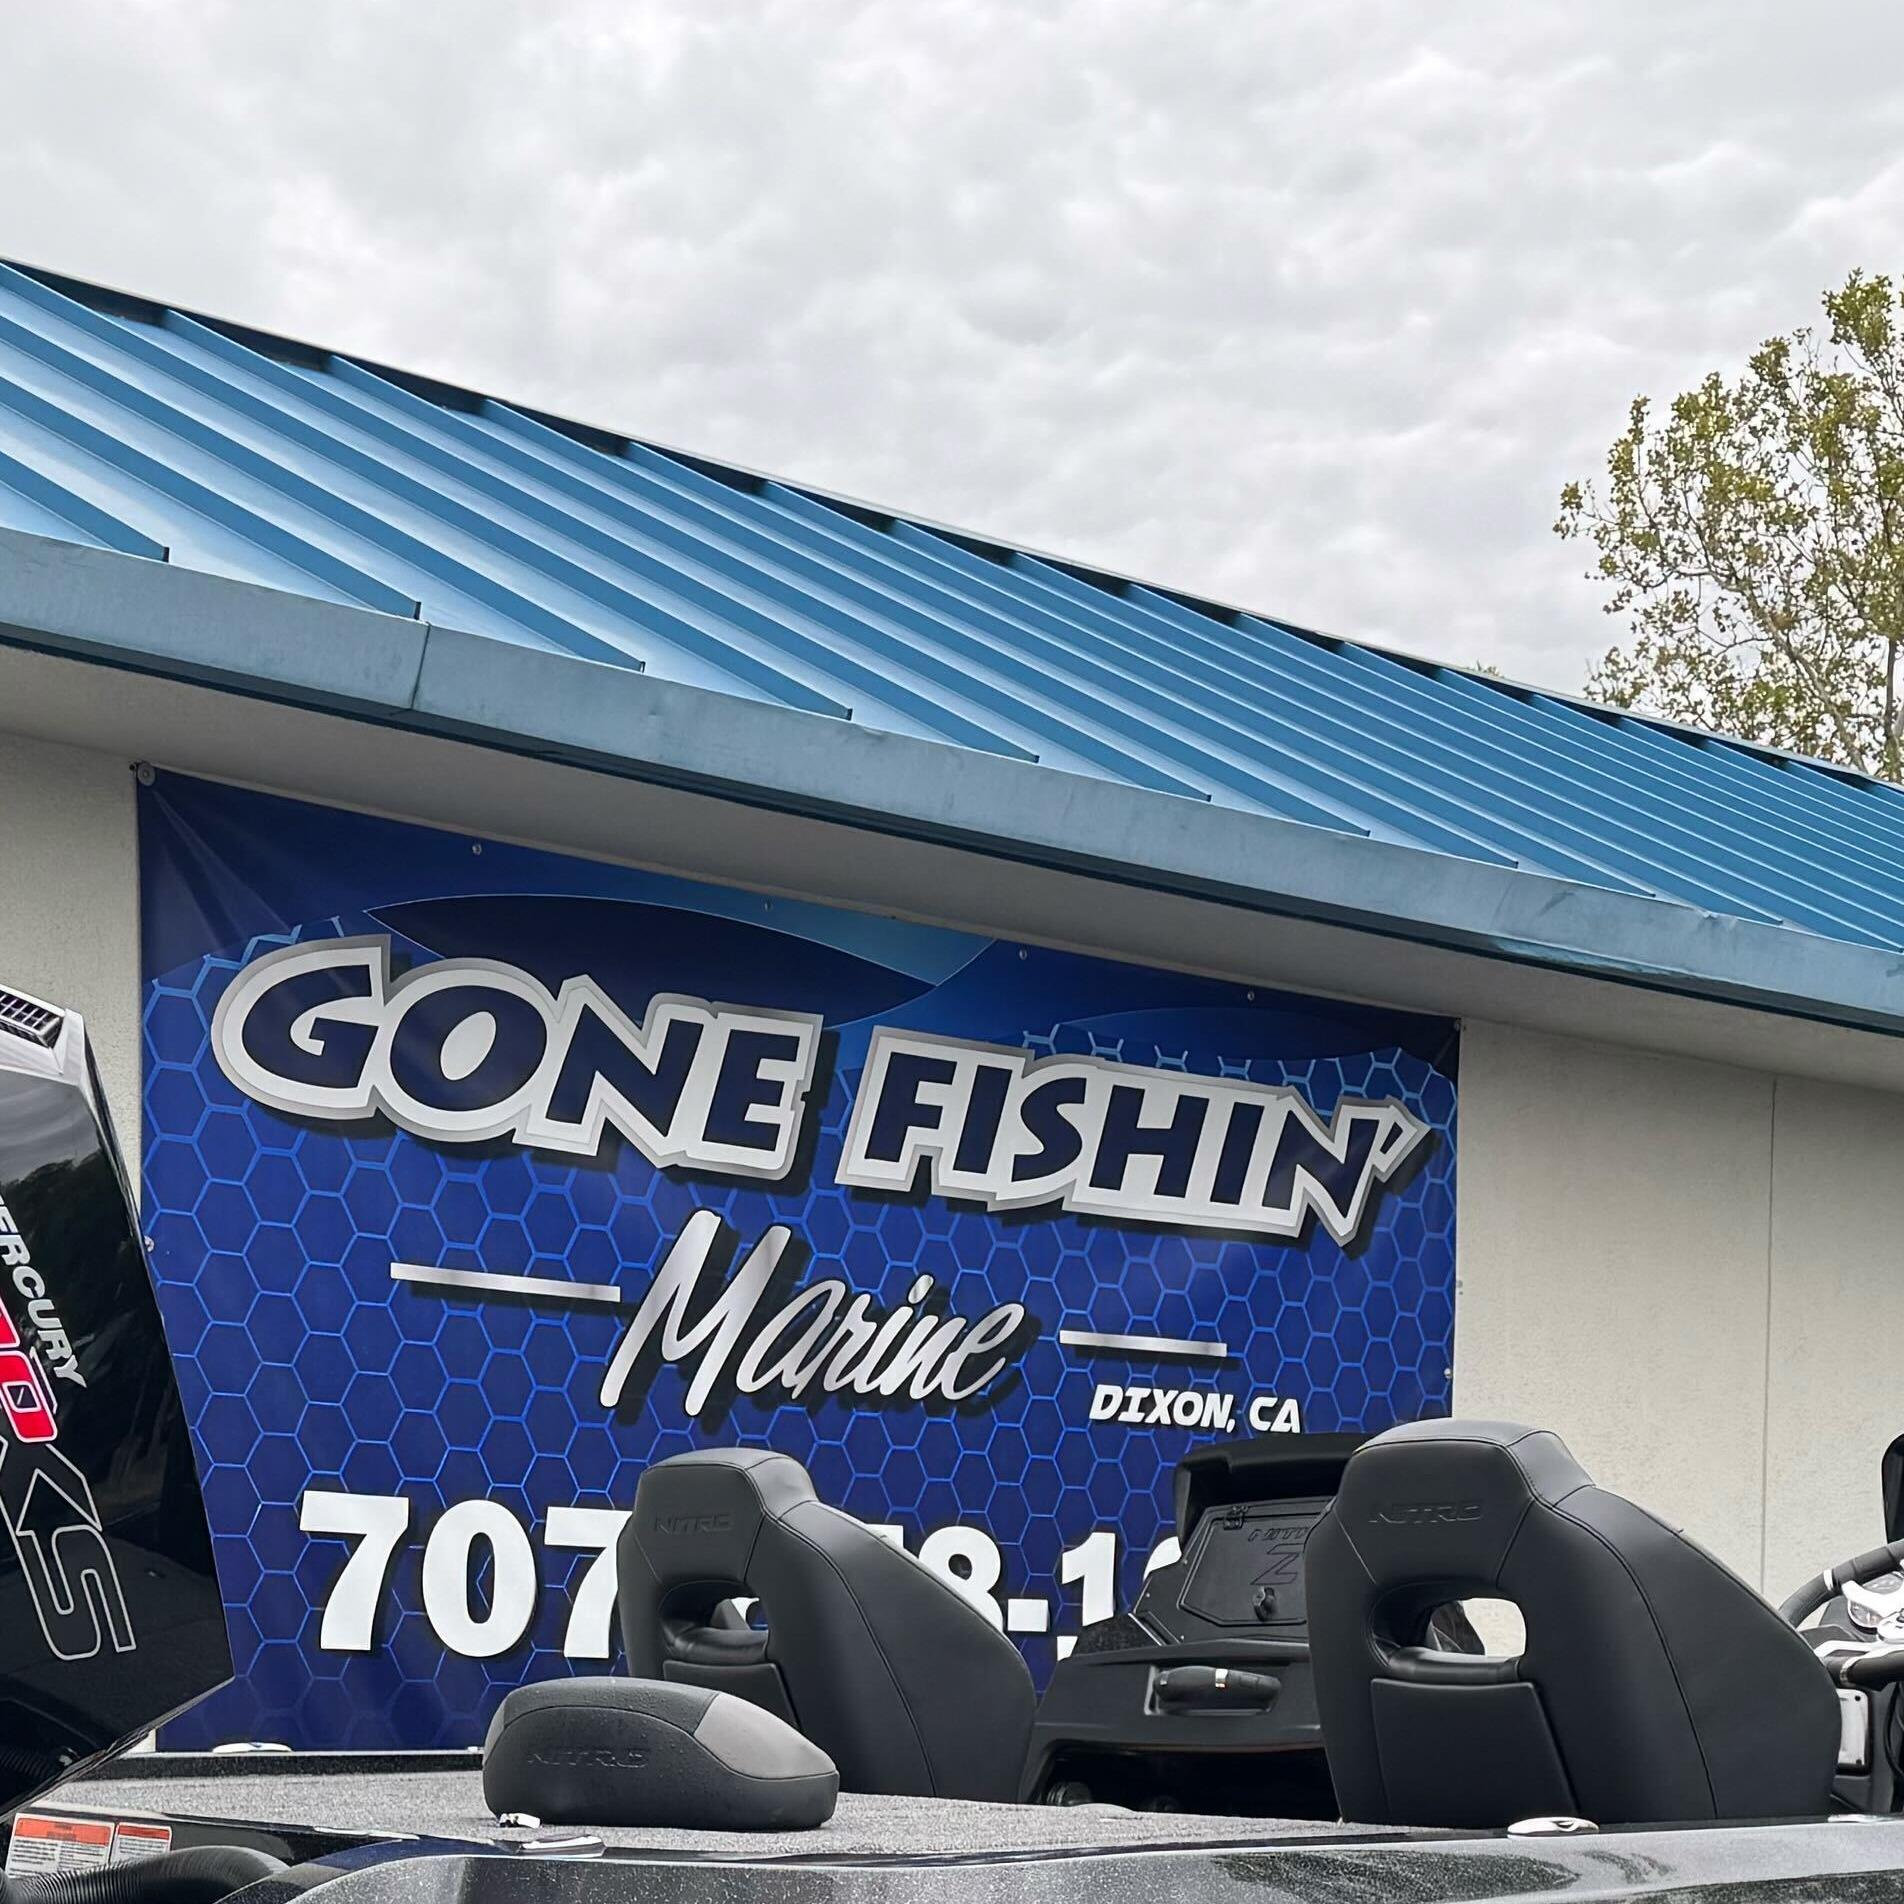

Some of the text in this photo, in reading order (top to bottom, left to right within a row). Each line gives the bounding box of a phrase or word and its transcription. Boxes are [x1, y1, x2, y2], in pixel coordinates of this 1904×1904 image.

[218, 942, 1424, 1240] GONE FISHIN'
[600, 1210, 1025, 1417] Marine
[1089, 1384, 1301, 1433] DIXON, CA
